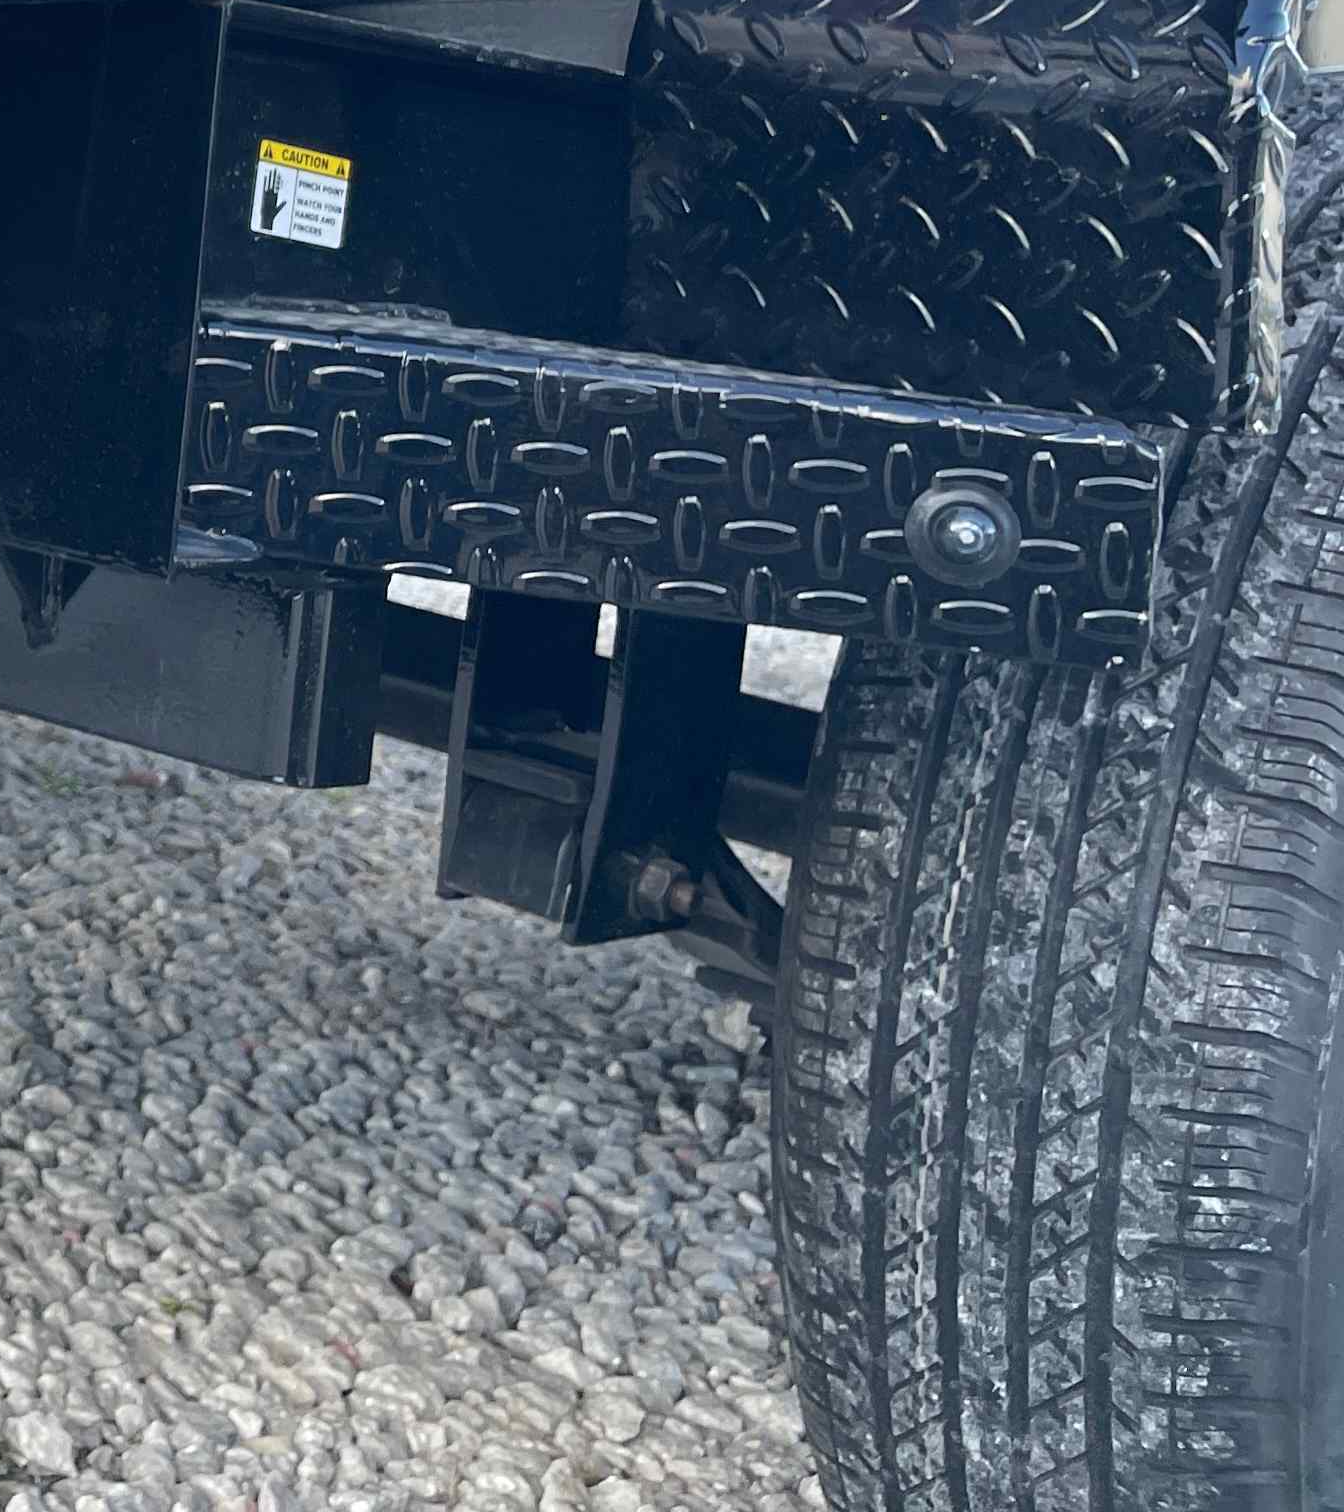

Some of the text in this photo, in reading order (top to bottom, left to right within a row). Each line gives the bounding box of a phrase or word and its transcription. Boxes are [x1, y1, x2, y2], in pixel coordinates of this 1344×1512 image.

[281, 148, 330, 171] CAUTION
[298, 179, 345, 198] PINCH POINT
